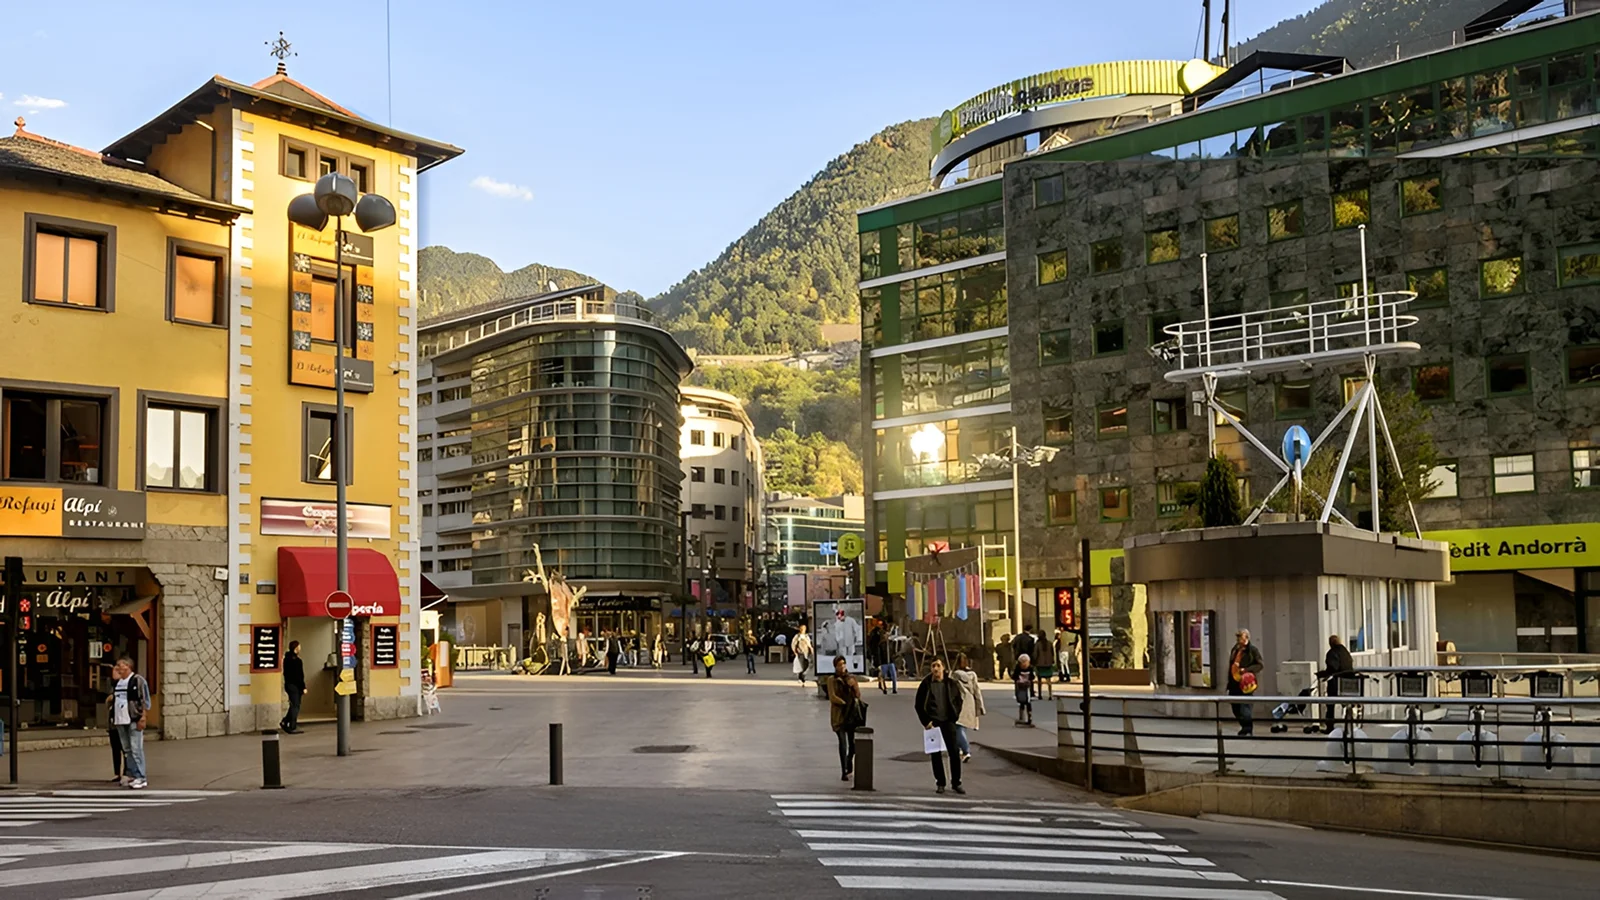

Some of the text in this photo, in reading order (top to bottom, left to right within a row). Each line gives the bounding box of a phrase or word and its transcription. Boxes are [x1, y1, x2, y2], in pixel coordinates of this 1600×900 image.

[63, 497, 102, 516] Alpi
[69, 519, 144, 529] RESTAURANT
[1450, 536, 1587, 559] èdit Andorrà
[46, 590, 92, 613] Alpi
